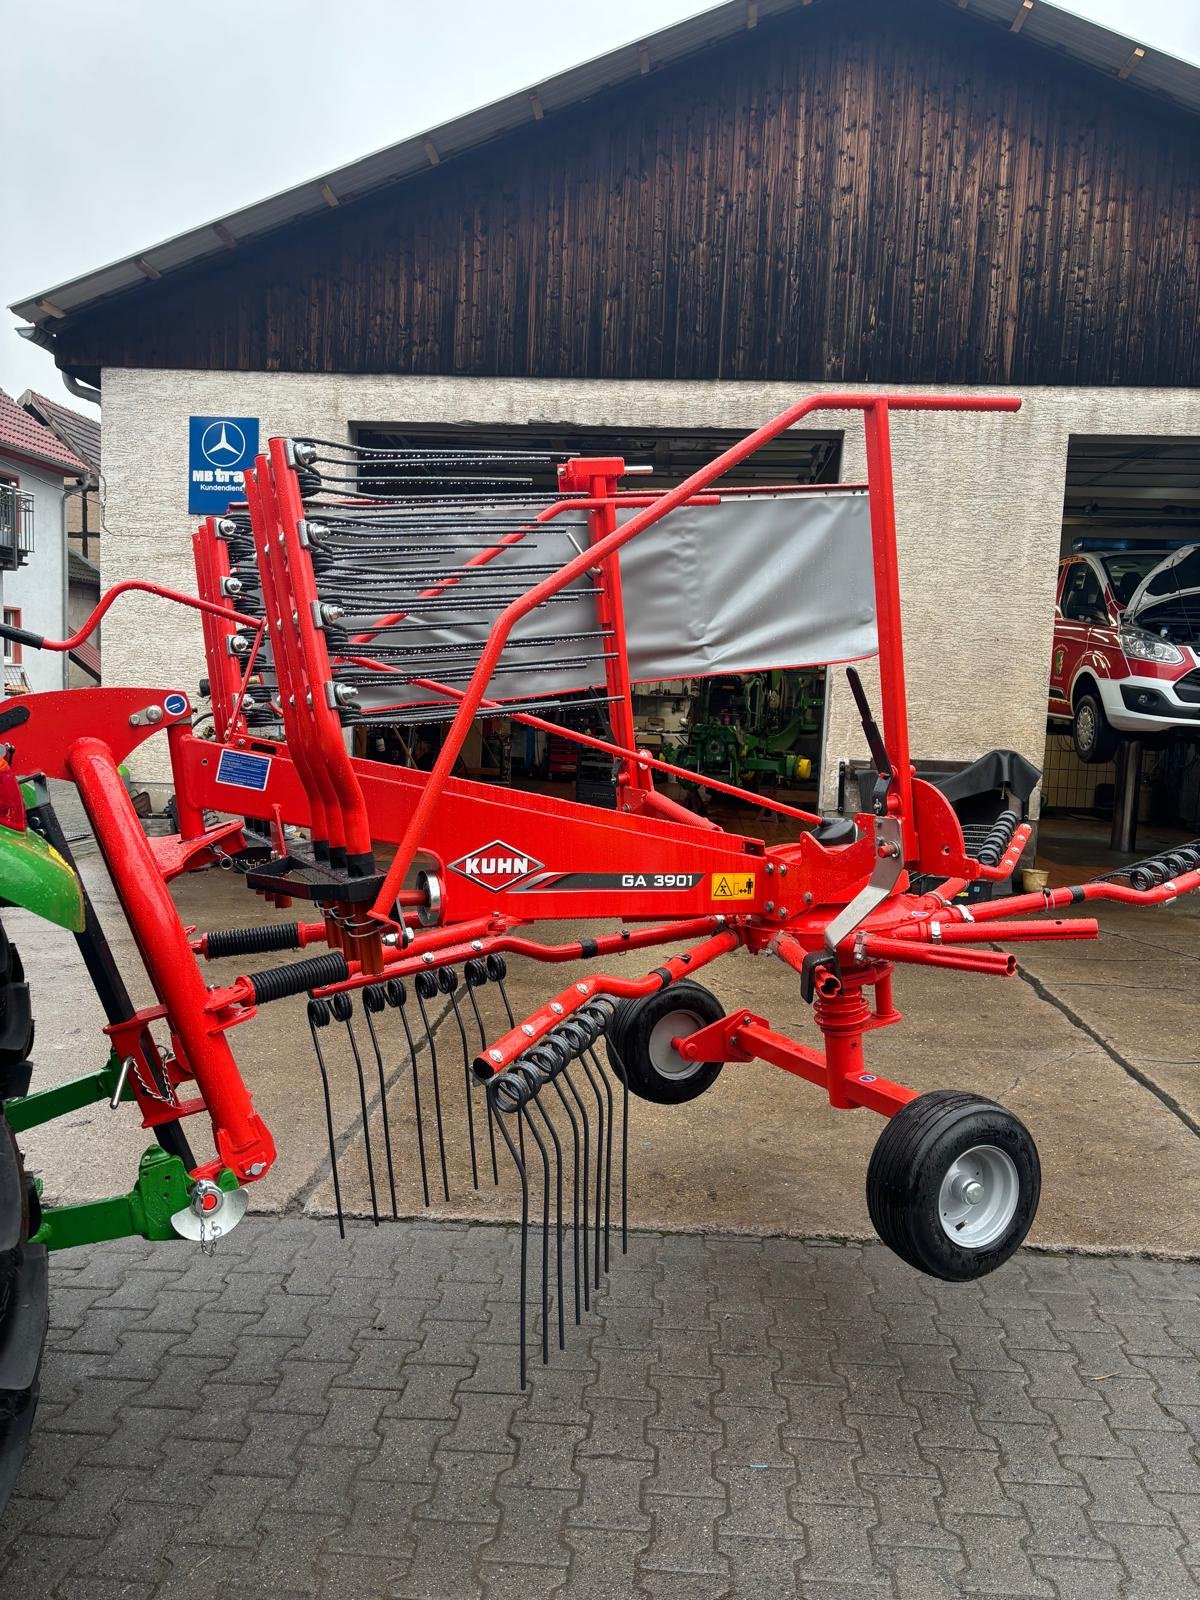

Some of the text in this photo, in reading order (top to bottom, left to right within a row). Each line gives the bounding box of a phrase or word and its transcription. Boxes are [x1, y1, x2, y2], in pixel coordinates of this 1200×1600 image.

[192, 468, 244, 482] MB tra
[200, 484, 244, 492] Kundendiens
[465, 858, 528, 874] KUHN
[621, 874, 693, 887] GA 3901
